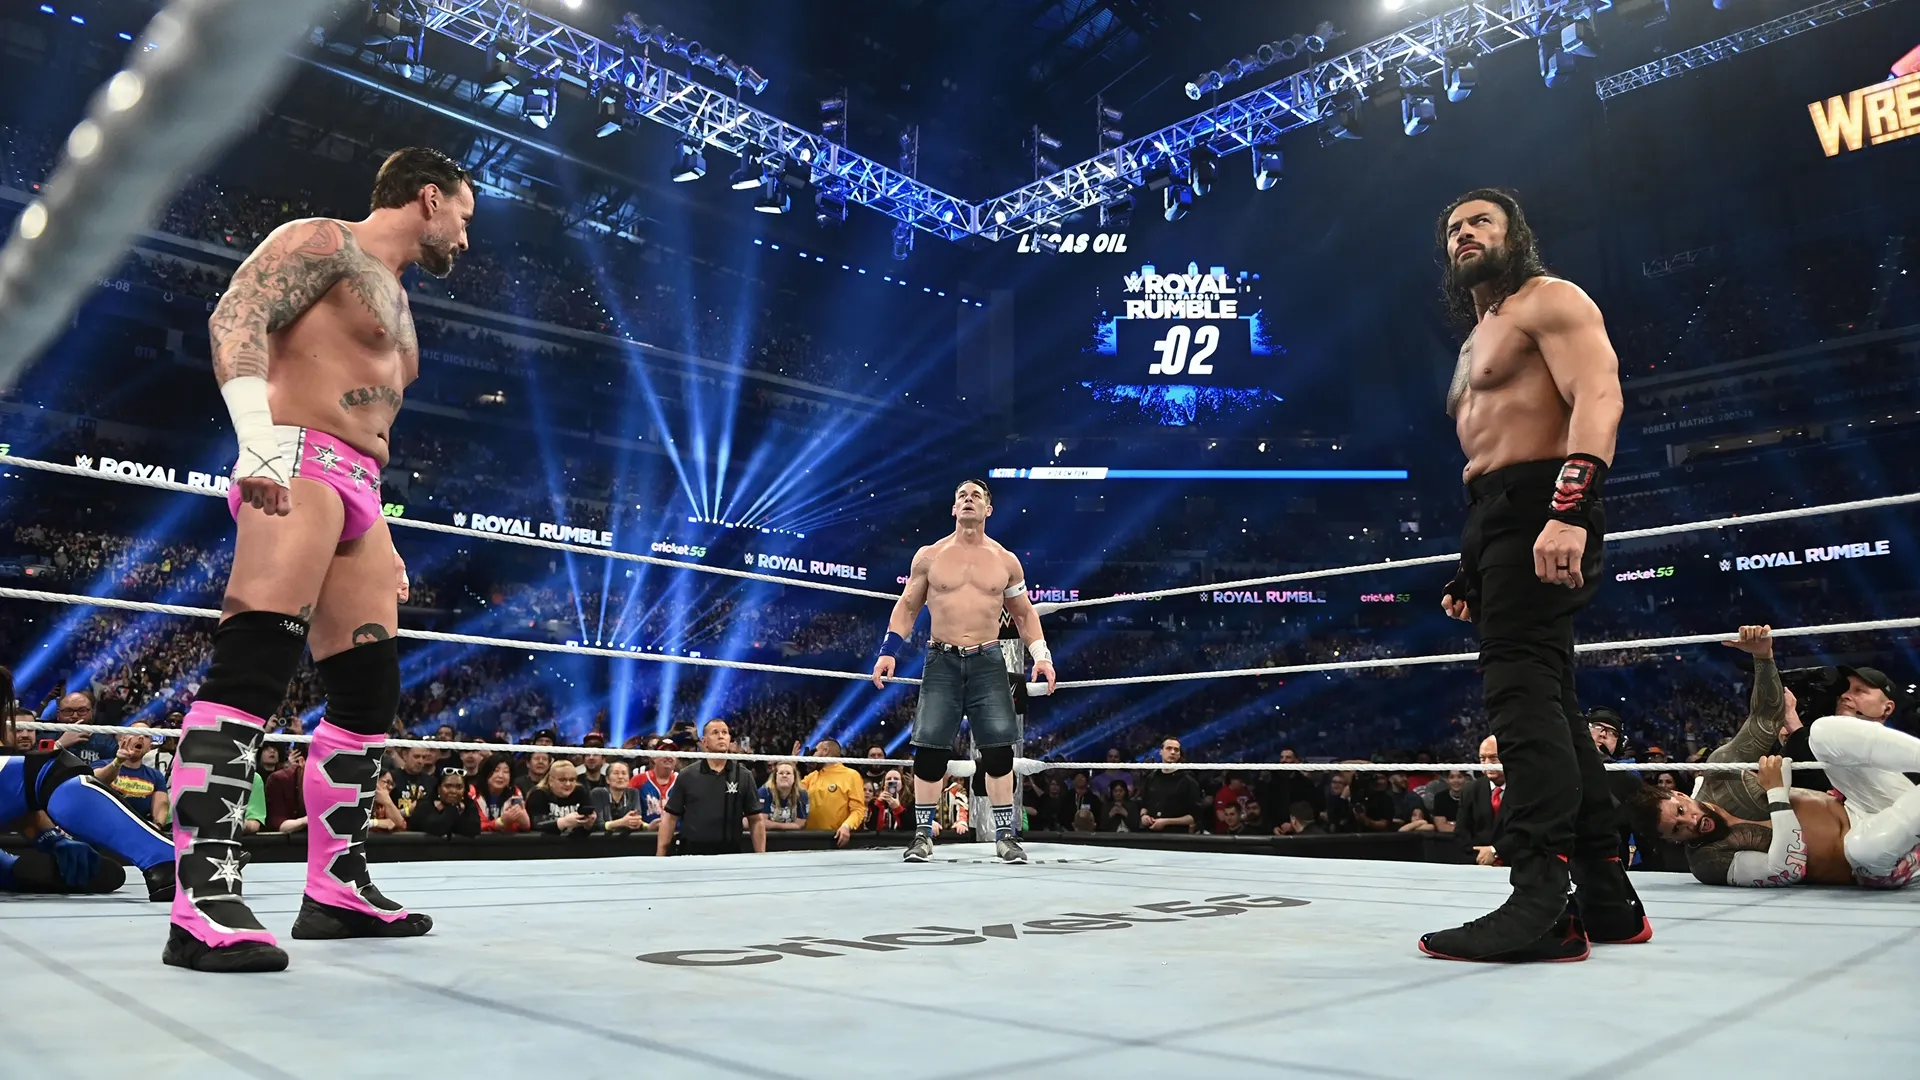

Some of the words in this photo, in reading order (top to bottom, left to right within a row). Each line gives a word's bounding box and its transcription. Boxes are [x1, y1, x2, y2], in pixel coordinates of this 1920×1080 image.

[1093, 233, 1128, 253] OIL
[1144, 273, 1236, 294] ROYAL
[1144, 293, 1221, 301] INDIANAPOLIS
[1126, 299, 1237, 320] RUMBLE
[1642, 421, 1676, 436] ROBERT
[1679, 415, 1714, 429] MATHIS
[99, 456, 176, 483] ROYAL
[471, 513, 536, 538] ROYAL
[539, 522, 613, 547] RUMBLE
[1735, 550, 1803, 571] ROYAL
[1805, 540, 1891, 563] RUMBLE
[758, 553, 808, 574] ROYAL
[810, 560, 867, 581] RUMBLE
[1028, 590, 1080, 602] UMBLE
[1213, 590, 1263, 604] ROYAL
